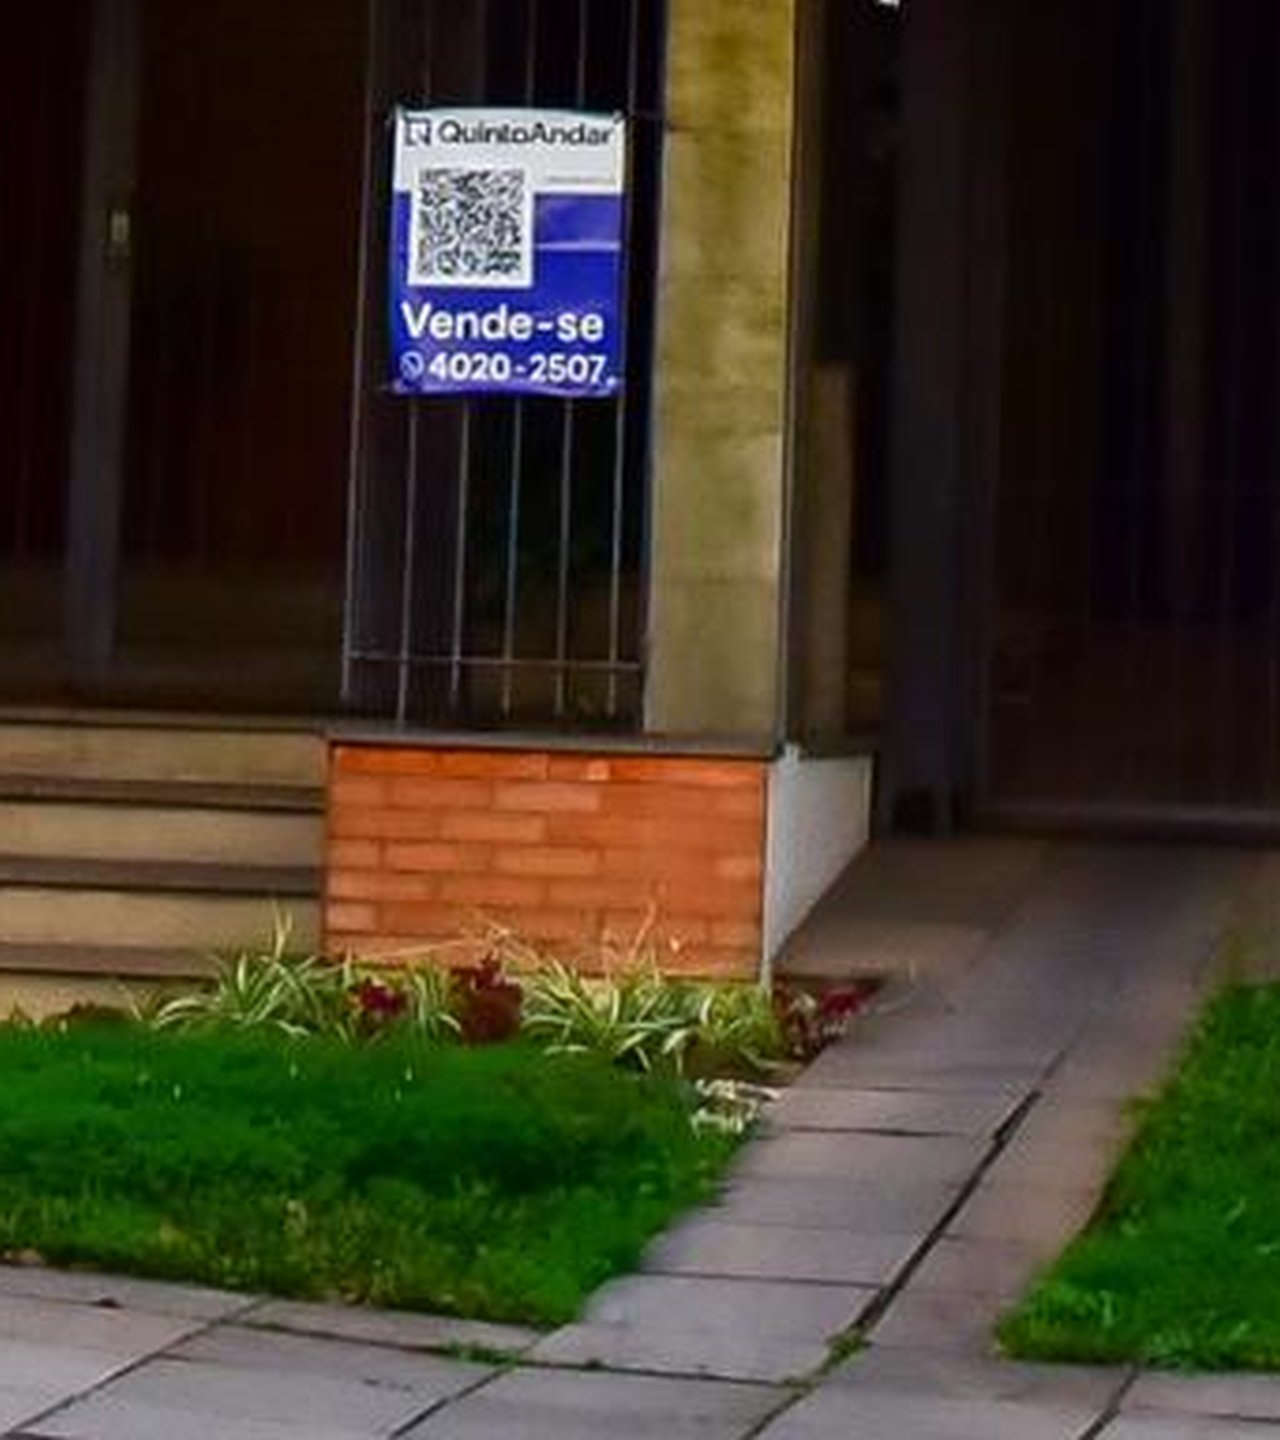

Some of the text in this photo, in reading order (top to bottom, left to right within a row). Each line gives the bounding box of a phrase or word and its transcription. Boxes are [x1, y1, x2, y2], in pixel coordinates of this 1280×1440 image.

[438, 120, 612, 146] QuintoAndar
[400, 302, 605, 341] Vende-se
[428, 352, 607, 384] 4020-2507
